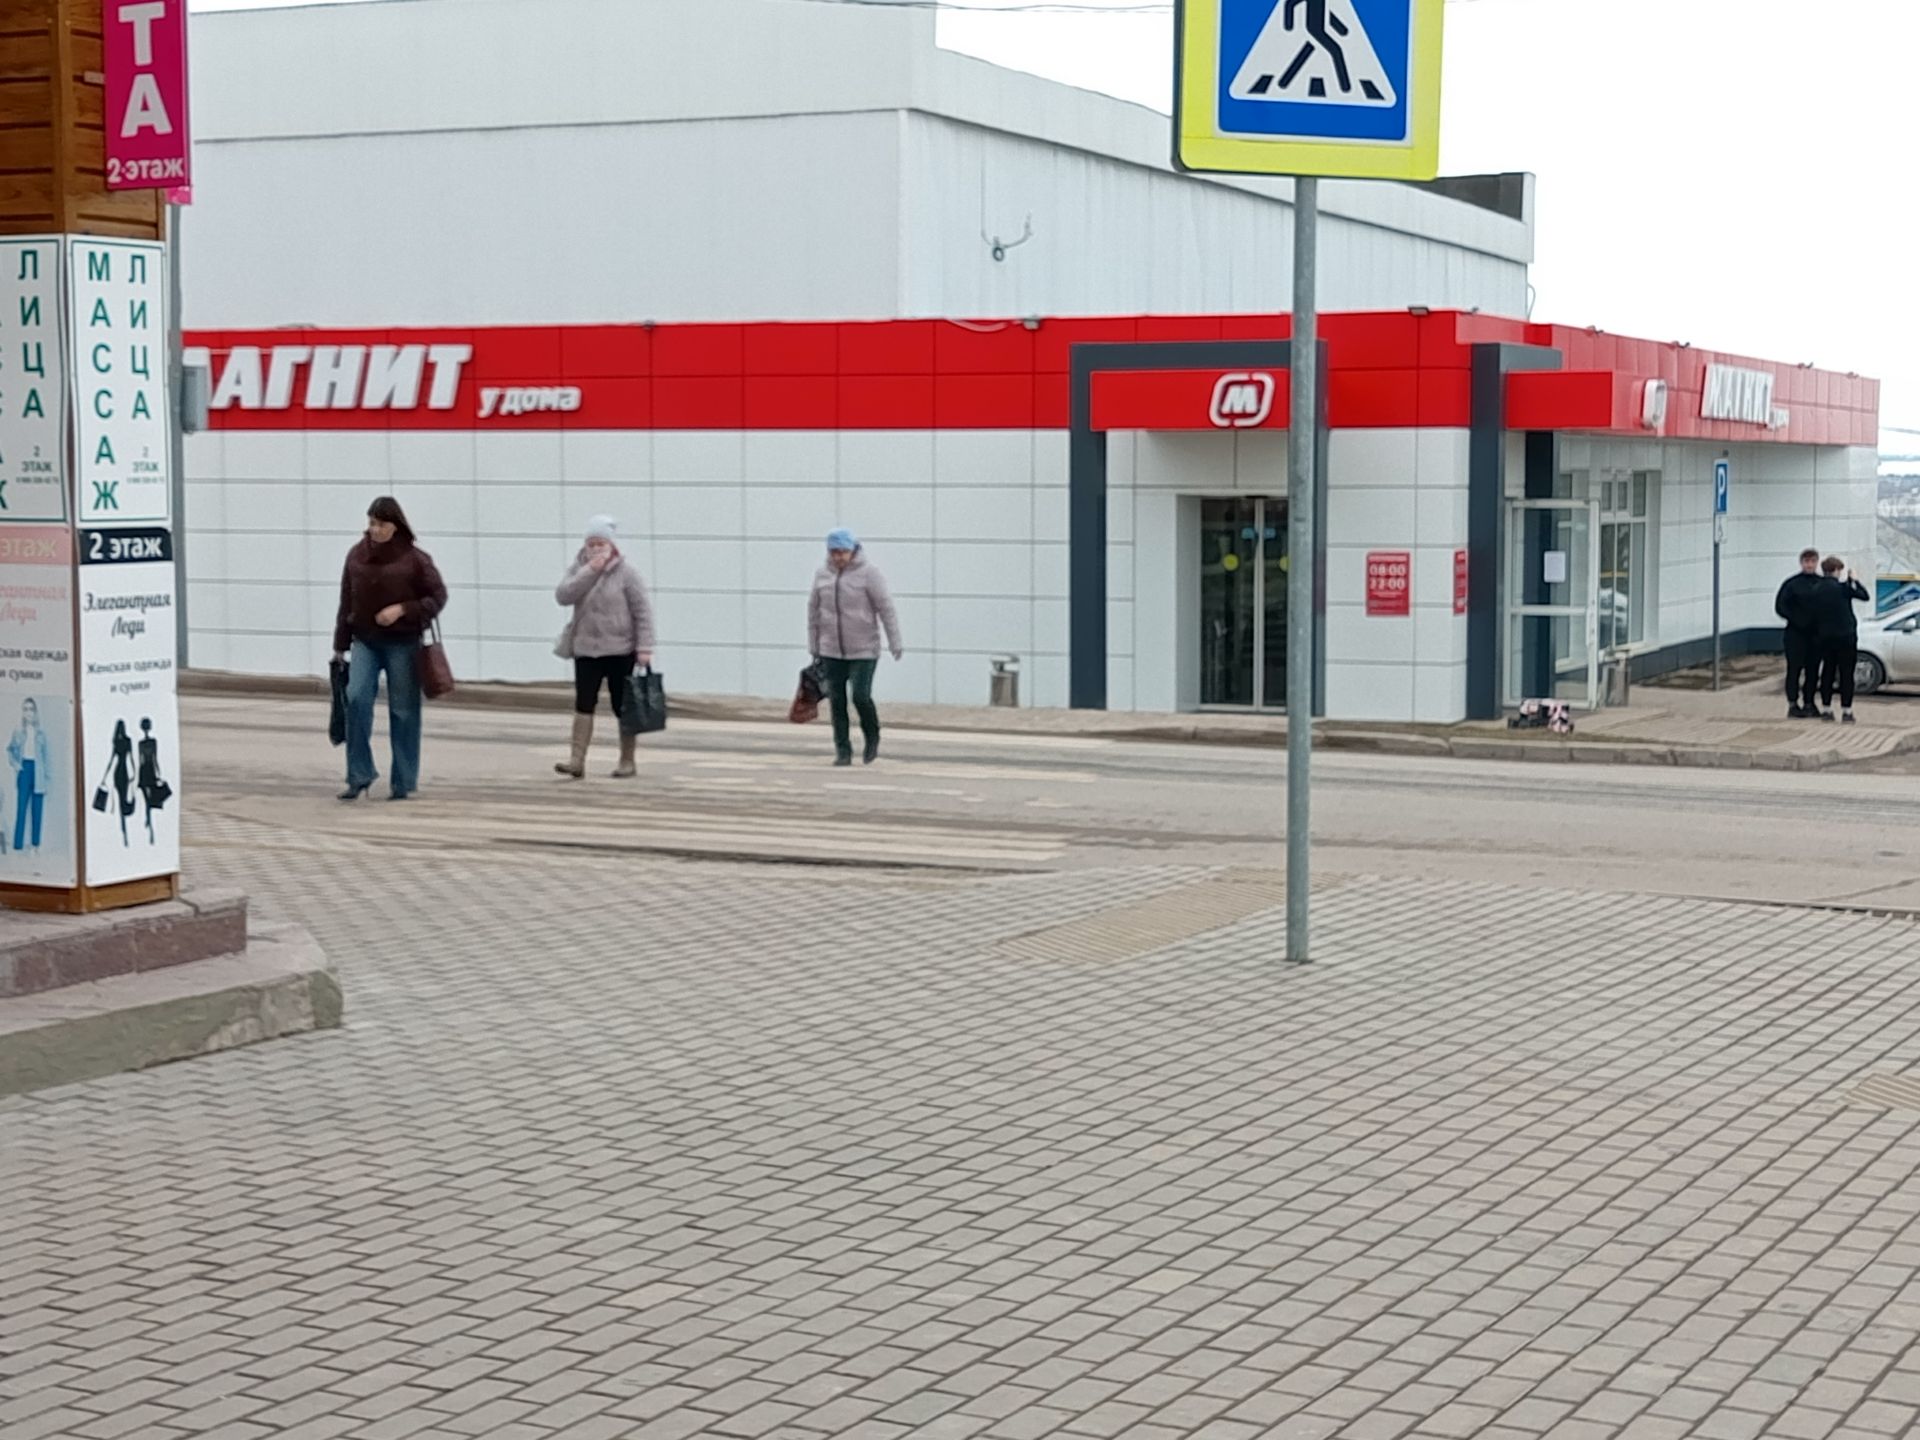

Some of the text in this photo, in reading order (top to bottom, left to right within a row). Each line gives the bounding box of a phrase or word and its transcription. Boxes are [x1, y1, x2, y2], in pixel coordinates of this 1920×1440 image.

[18, 249, 45, 418] ЛИЦА
[128, 255, 151, 420] ЛИЦА
[88, 251, 119, 510] МАССАЖ
[478, 386, 581, 417] у дома
[89, 533, 163, 559] 2 этаж
[83, 592, 171, 614] Элегантная
[111, 616, 145, 639] Леди
